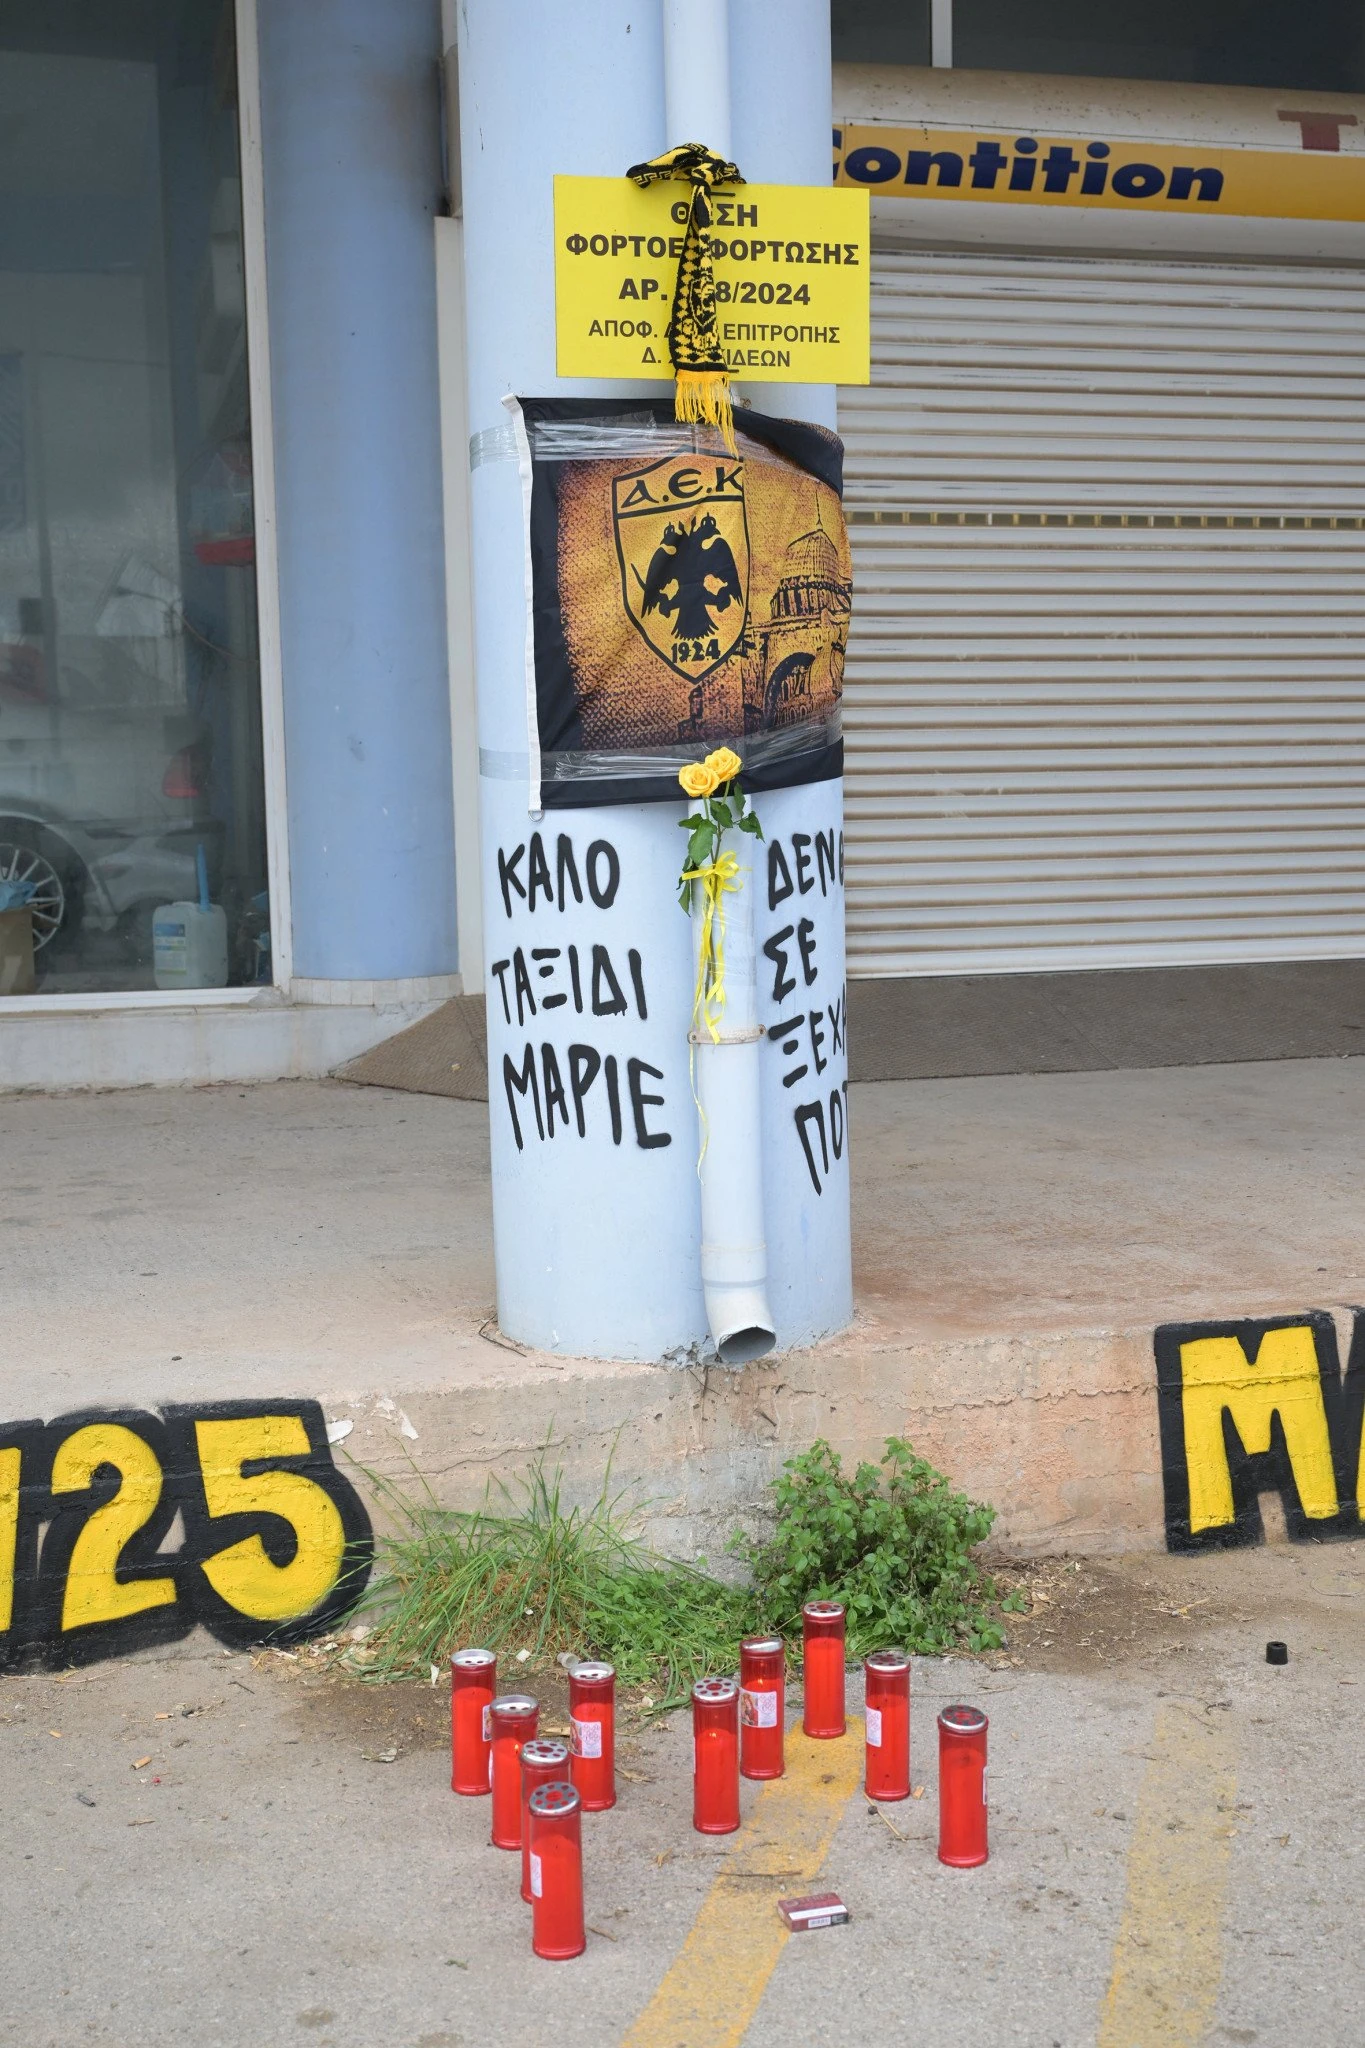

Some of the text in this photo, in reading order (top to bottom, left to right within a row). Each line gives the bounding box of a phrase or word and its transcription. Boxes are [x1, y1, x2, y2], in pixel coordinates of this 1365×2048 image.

[833, 128, 1224, 202] ontition
[671, 201, 758, 227] ΘΣΗ
[566, 233, 859, 265] ΦΟΡΤΟΕΦΟΡΤΩΣΗΣ
[619, 278, 668, 301] ΑΡ.
[588, 319, 658, 338] ΑΠΟΦ.
[723, 323, 841, 343] ΕΠΙΤΡΟΠΗΣ
[641, 347, 662, 364] Δ.
[671, 639, 721, 663] 1924
[498, 832, 620, 918] ΚΑΛΟ
[764, 918, 818, 1003] ΣΕ
[492, 945, 648, 1026] ΤΑΞΙΔΙ
[503, 1042, 672, 1152] ΜΑΡΙΕ
